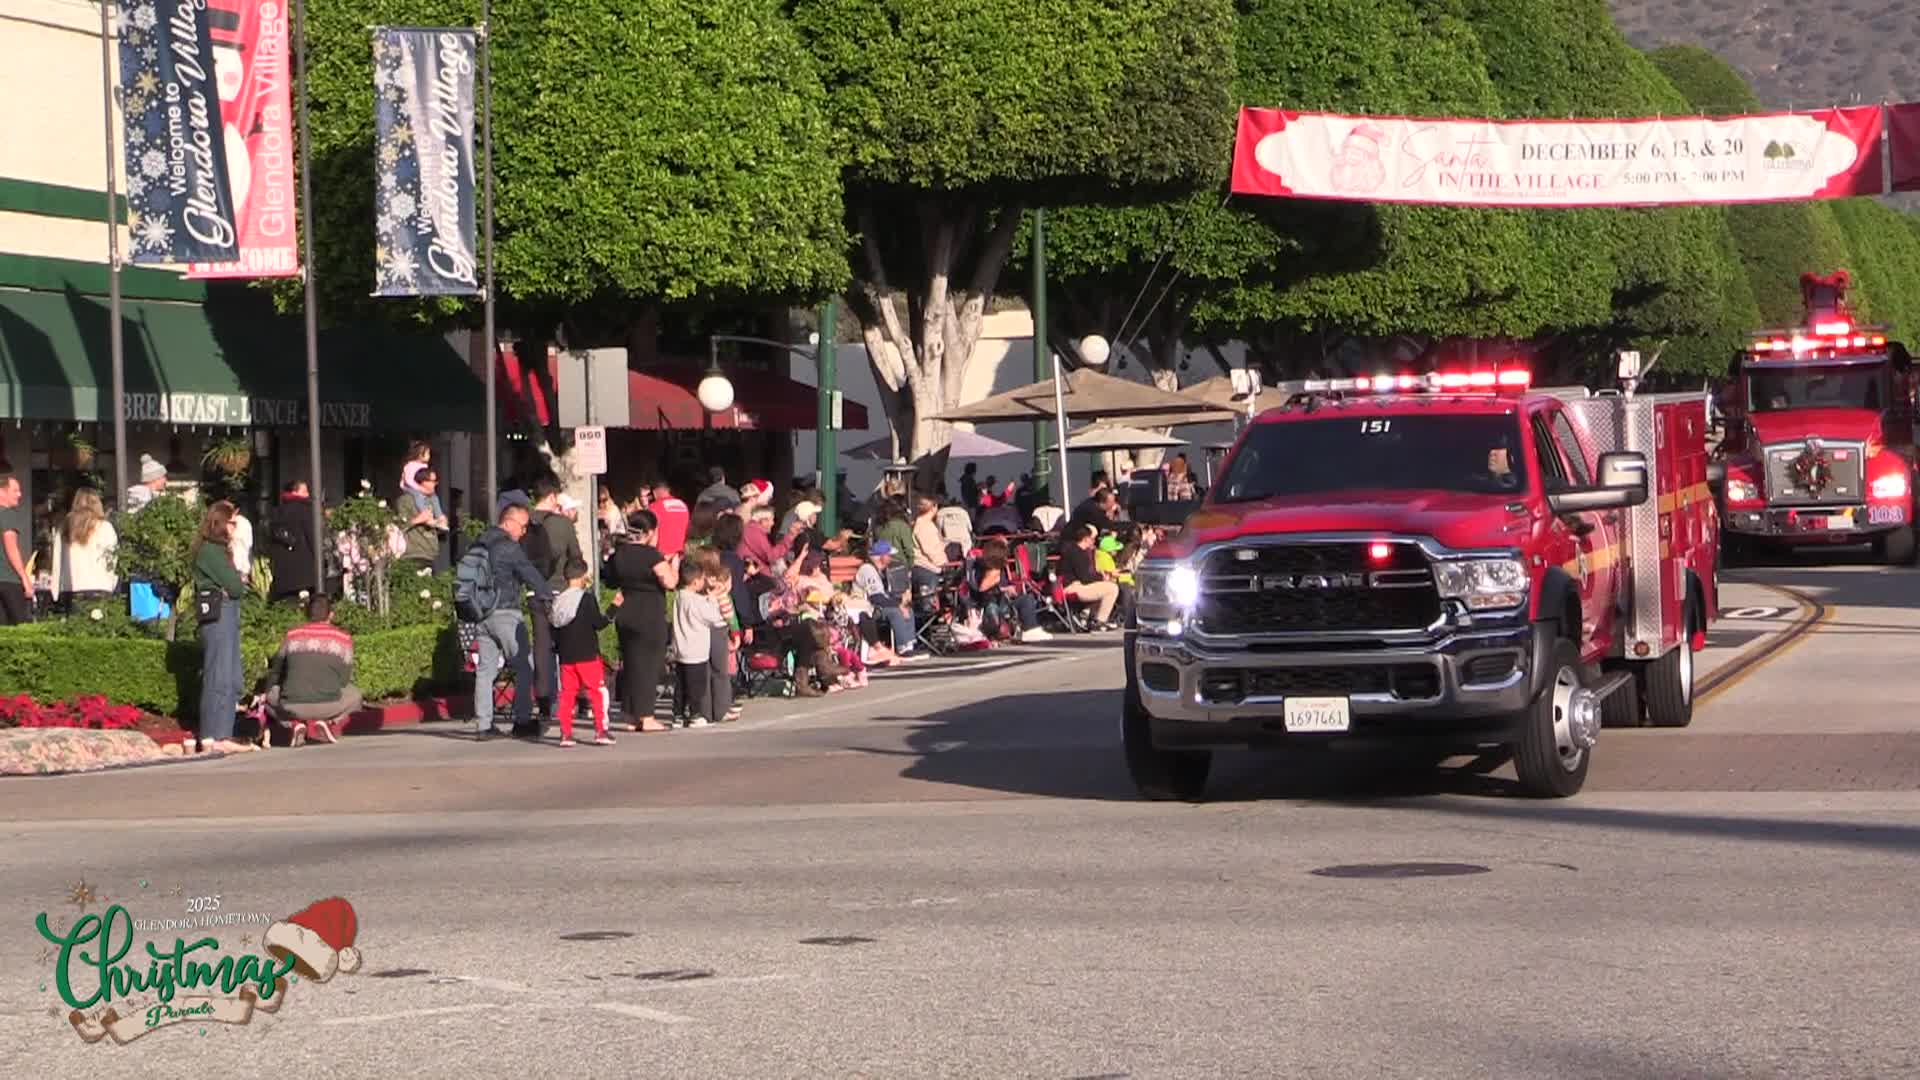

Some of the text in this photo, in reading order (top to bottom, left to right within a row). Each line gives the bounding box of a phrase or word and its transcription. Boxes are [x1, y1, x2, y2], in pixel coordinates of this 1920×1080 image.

[165, 82, 187, 197] Welcome to
[253, 1, 286, 237] Glendora Village
[182, 91, 235, 249] Glendora
[428, 32, 477, 286] Glendora Village
[1401, 126, 1497, 192] Santa
[1521, 138, 1744, 161] DECEMBER 6, 13, & 20
[1439, 173, 1458, 188] IN
[1514, 173, 1604, 189] VILLAGE
[1655, 171, 1678, 184] PM
[123, 392, 229, 423] BREAKFAST
[240, 396, 298, 425] LUNCH
[318, 401, 370, 427] INNER
[1360, 420, 1391, 434] 151
